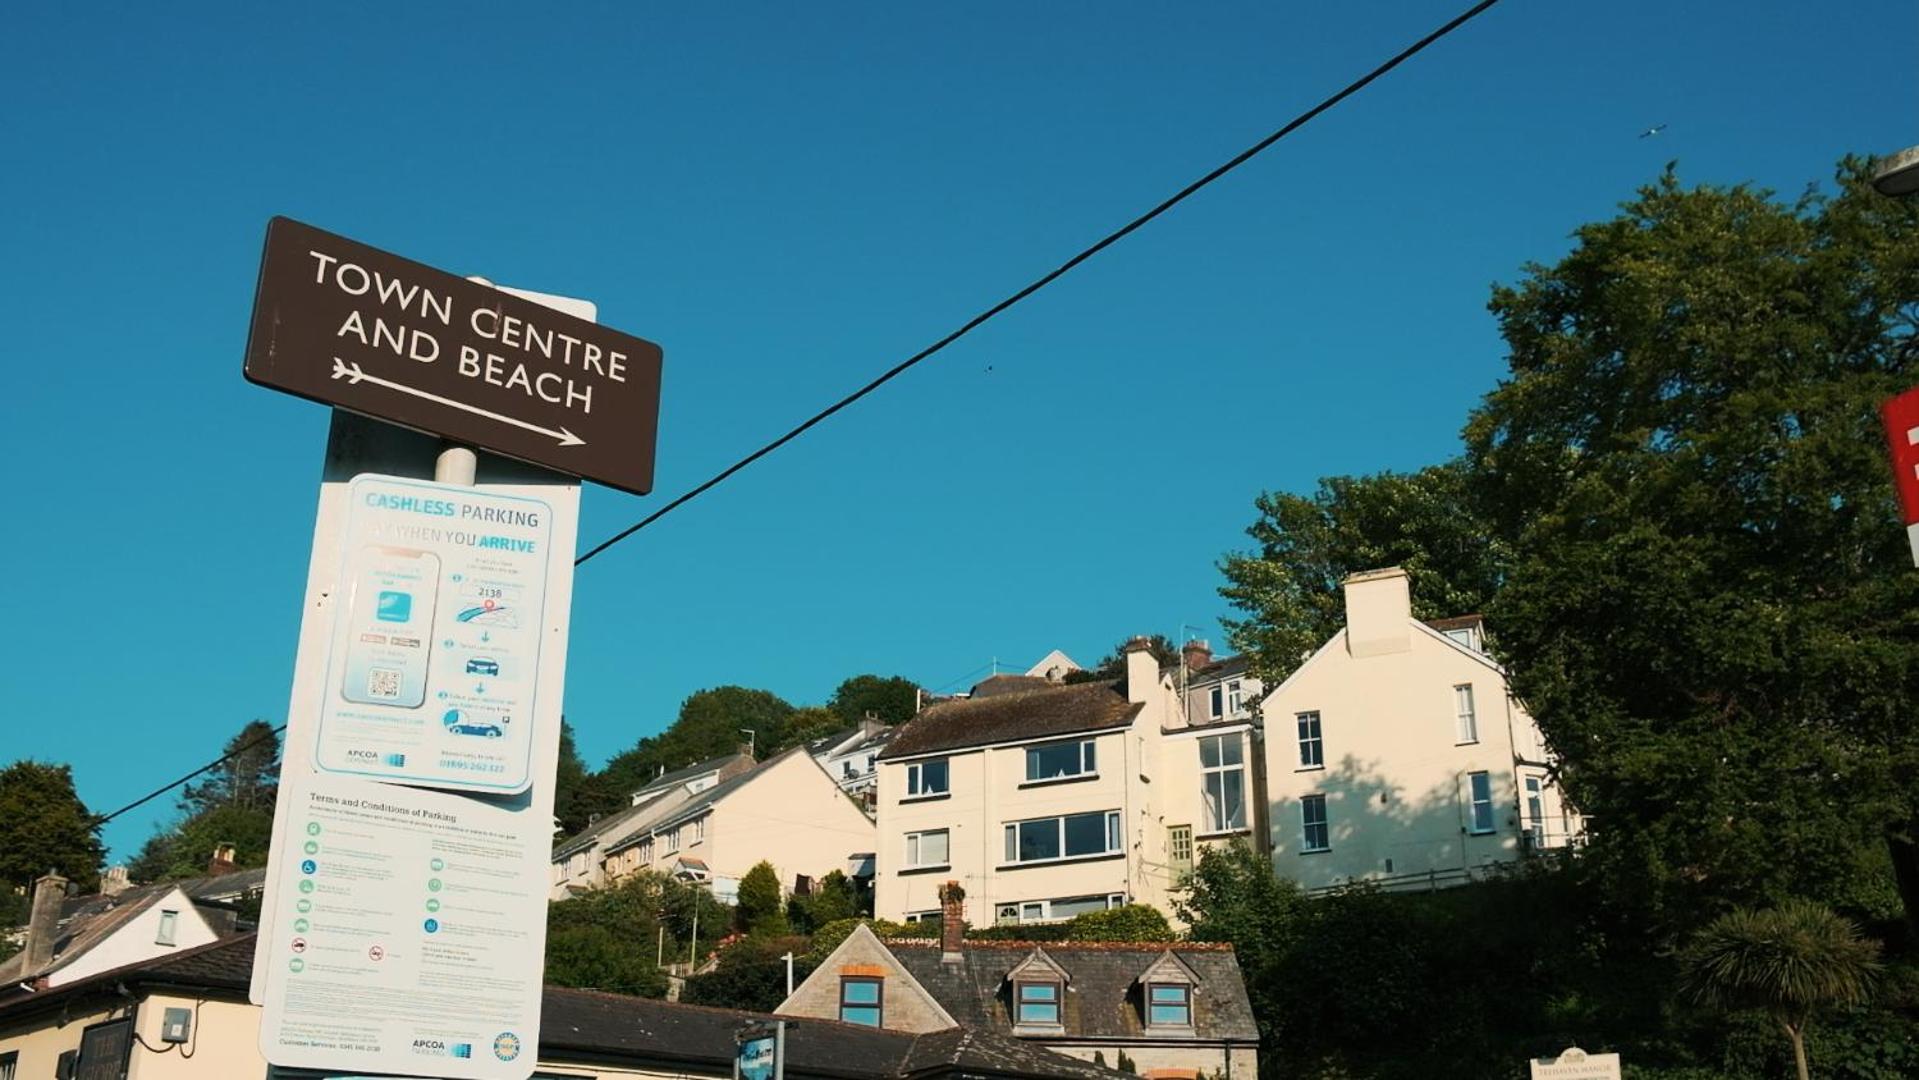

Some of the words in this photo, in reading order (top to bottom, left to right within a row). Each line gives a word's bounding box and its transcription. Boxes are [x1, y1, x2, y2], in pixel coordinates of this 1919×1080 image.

[310, 250, 453, 326] TOWN
[471, 308, 628, 383] CENTRE
[337, 310, 440, 363] AND
[458, 346, 592, 414] BEACH
[365, 492, 455, 517] CASHLESS
[462, 504, 539, 527] PARKING
[396, 524, 441, 543] WHEN
[445, 531, 476, 547] YOU
[478, 535, 536, 554] ARRIVE
[310, 792, 340, 806] Terms
[342, 797, 359, 808] and
[360, 799, 410, 817] Conditions
[411, 808, 421, 818] of
[423, 811, 457, 824] Parking
[413, 1039, 445, 1050] APCOA
